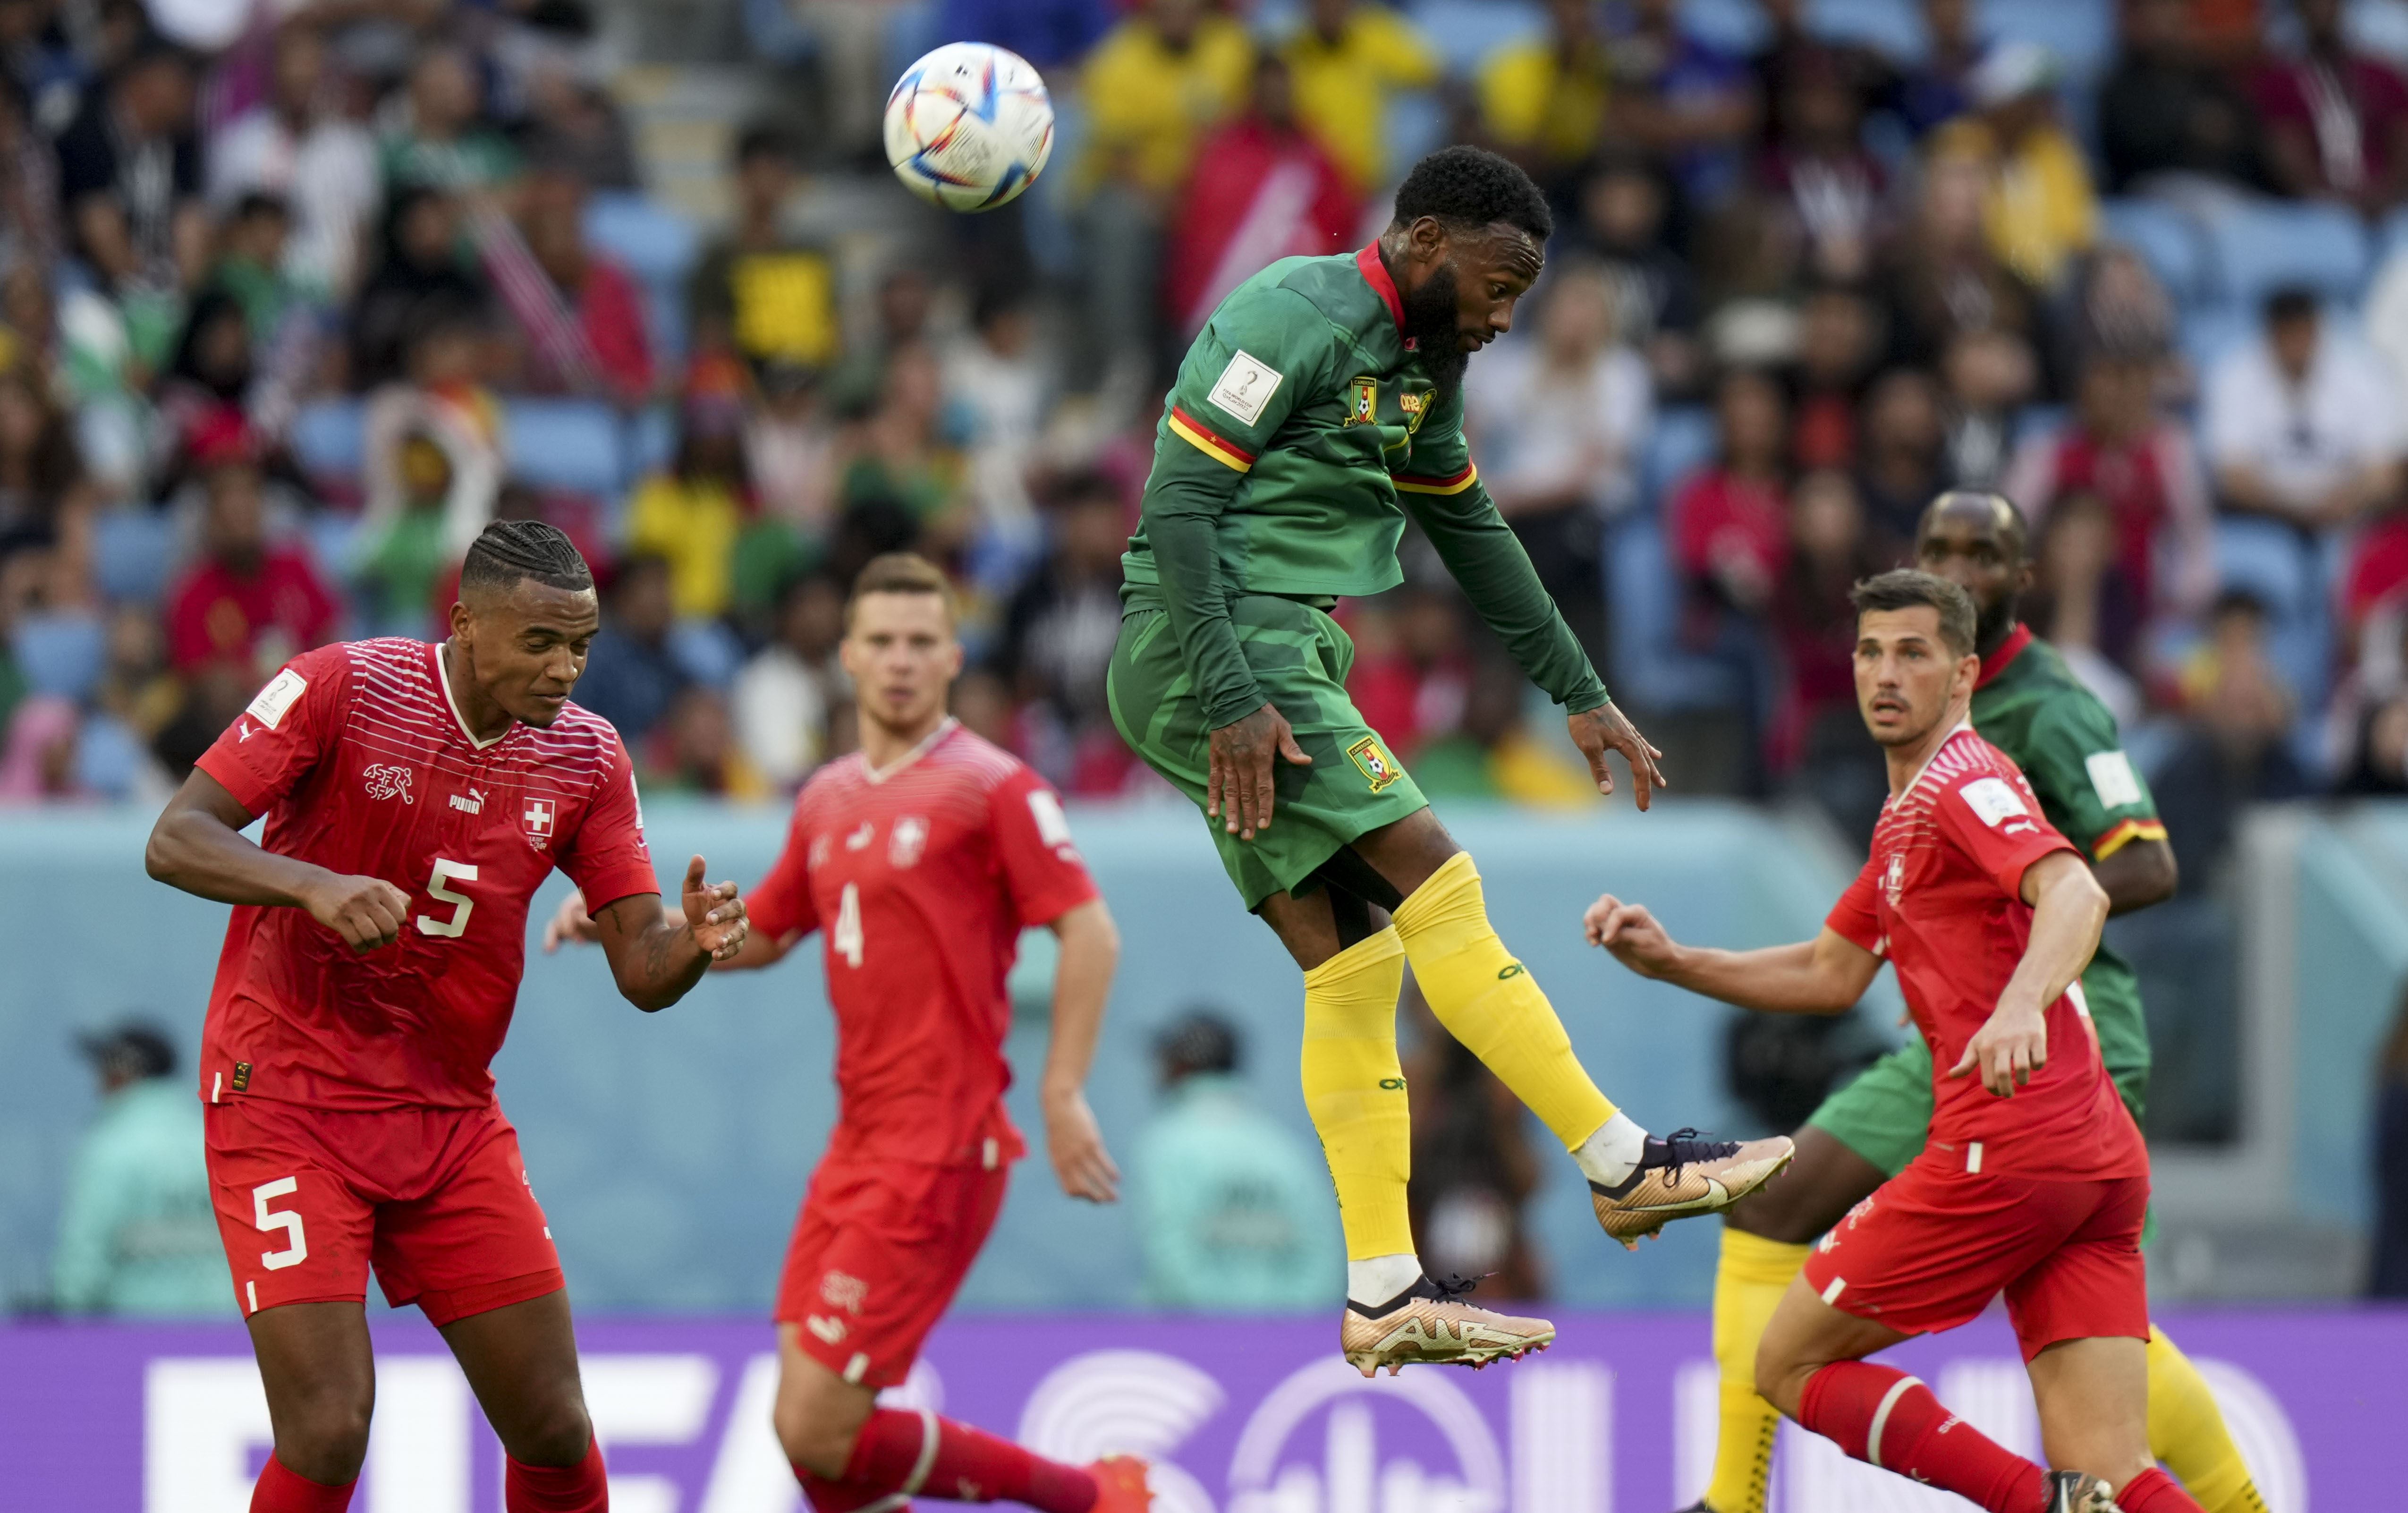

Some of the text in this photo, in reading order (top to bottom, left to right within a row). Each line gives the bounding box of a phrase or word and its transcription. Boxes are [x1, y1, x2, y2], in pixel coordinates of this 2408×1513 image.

[449, 794, 481, 815] PUMA
[417, 858, 478, 938] 5
[834, 881, 865, 969] 4
[253, 1175, 308, 1271] 5
